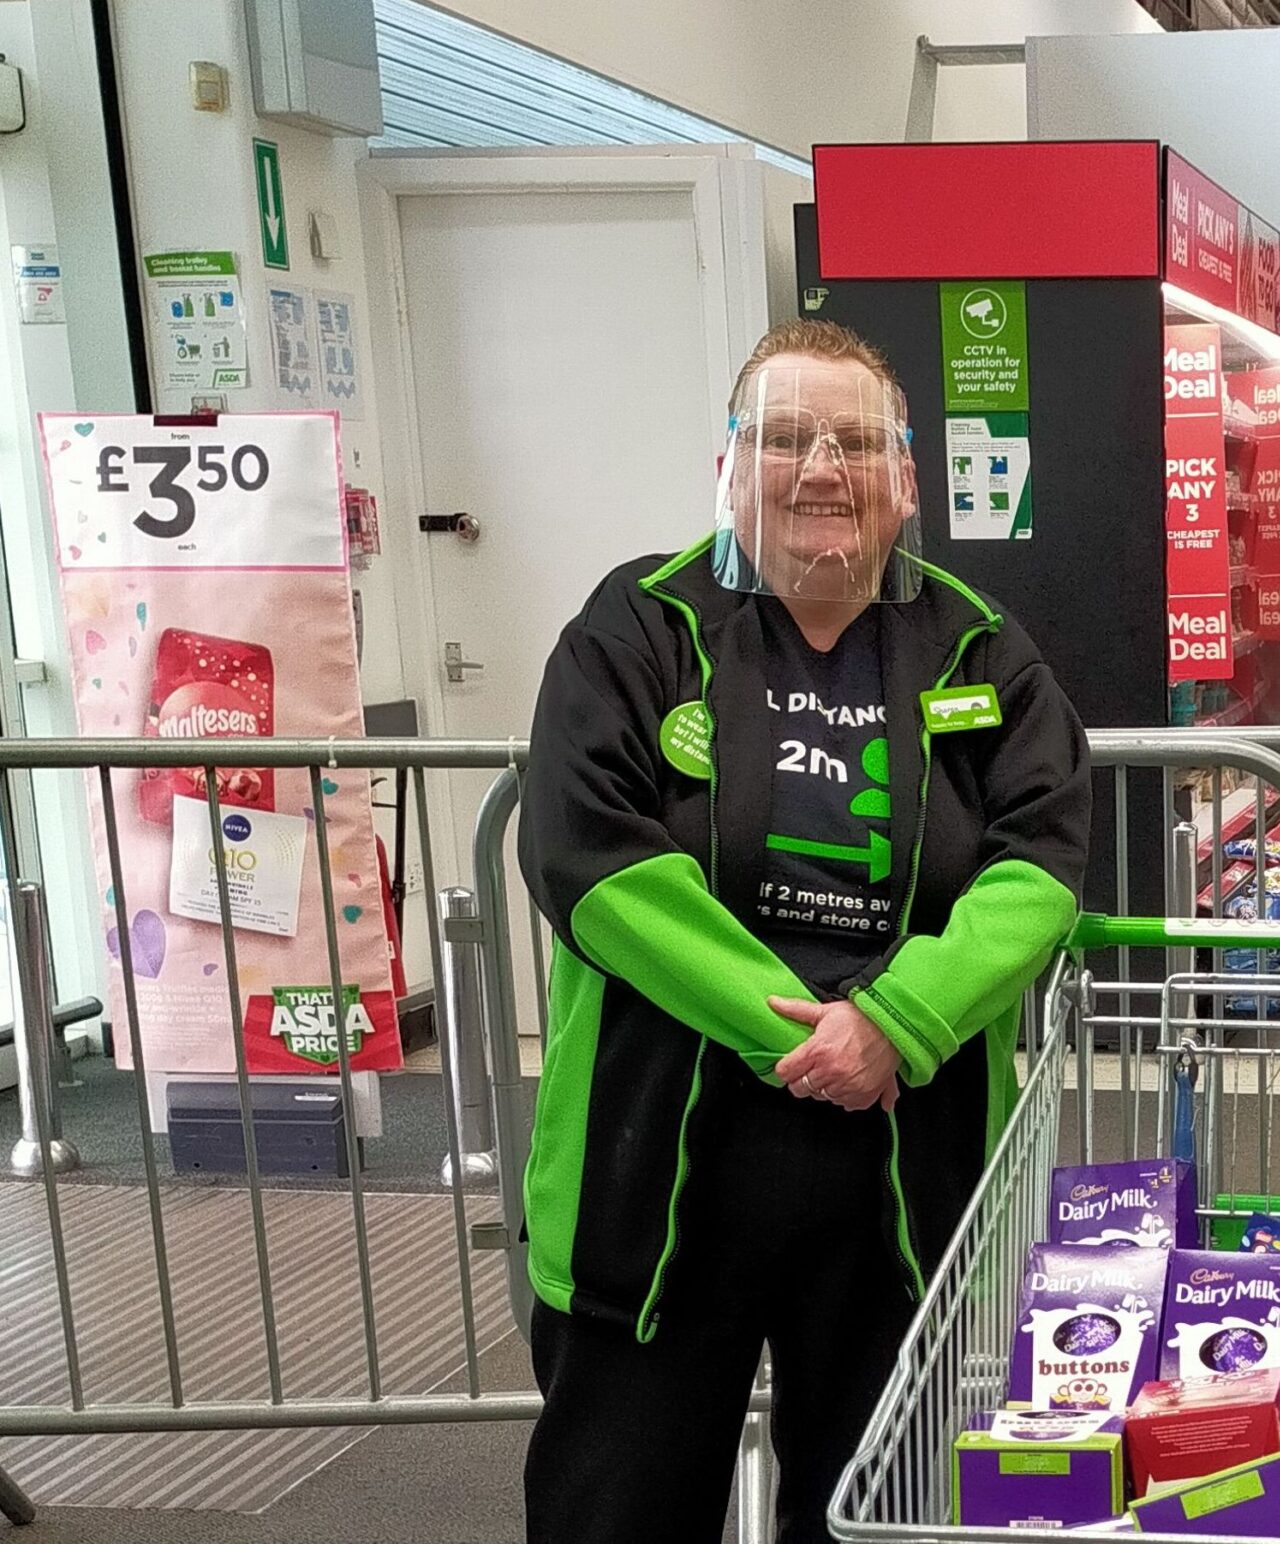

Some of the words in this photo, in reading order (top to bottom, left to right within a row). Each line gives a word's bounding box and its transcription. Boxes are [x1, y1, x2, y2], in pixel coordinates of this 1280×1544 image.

[1172, 178, 1189, 225] Meal
[1172, 223, 1188, 268] Deal
[964, 345, 994, 356] CCTV
[996, 345, 1007, 355] in
[1164, 344, 1216, 372] Meal
[951, 357, 1002, 369] operation
[1005, 356, 1021, 367] for
[954, 370, 996, 381] security
[998, 369, 1019, 379] and
[957, 383, 981, 394] your
[983, 381, 1016, 393] safety
[1164, 372, 1216, 400] Deal
[170, 432, 190, 441] from
[1166, 458, 1217, 478] PICK
[1167, 481, 1216, 499] ANY
[1185, 504, 1200, 522] 3
[1167, 529, 1220, 540] CHEAPEST
[1175, 540, 1184, 549] IS
[1186, 539, 1213, 549] FREE
[177, 543, 196, 551] each
[1169, 610, 1227, 635] Meal
[1170, 636, 1227, 661] Deal
[159, 703, 257, 738] maltesers
[776, 740, 848, 783] 2m
[225, 824, 249, 834] NIVEA
[777, 886, 791, 901] 2
[797, 890, 864, 909] metres
[777, 909, 815, 922] and
[820, 912, 871, 930] store
[270, 1003, 376, 1036] ASDA
[1070, 1184, 1109, 1201] Cadbury
[1059, 1199, 1110, 1221] Dairy
[1111, 1189, 1158, 1211] Milk
[1031, 1271, 1089, 1294] Dairy
[1091, 1269, 1143, 1290] Milk
[1190, 1268, 1235, 1285] Cadbury
[1175, 1283, 1234, 1307] Dairy
[1038, 1360, 1130, 1376] buttons
